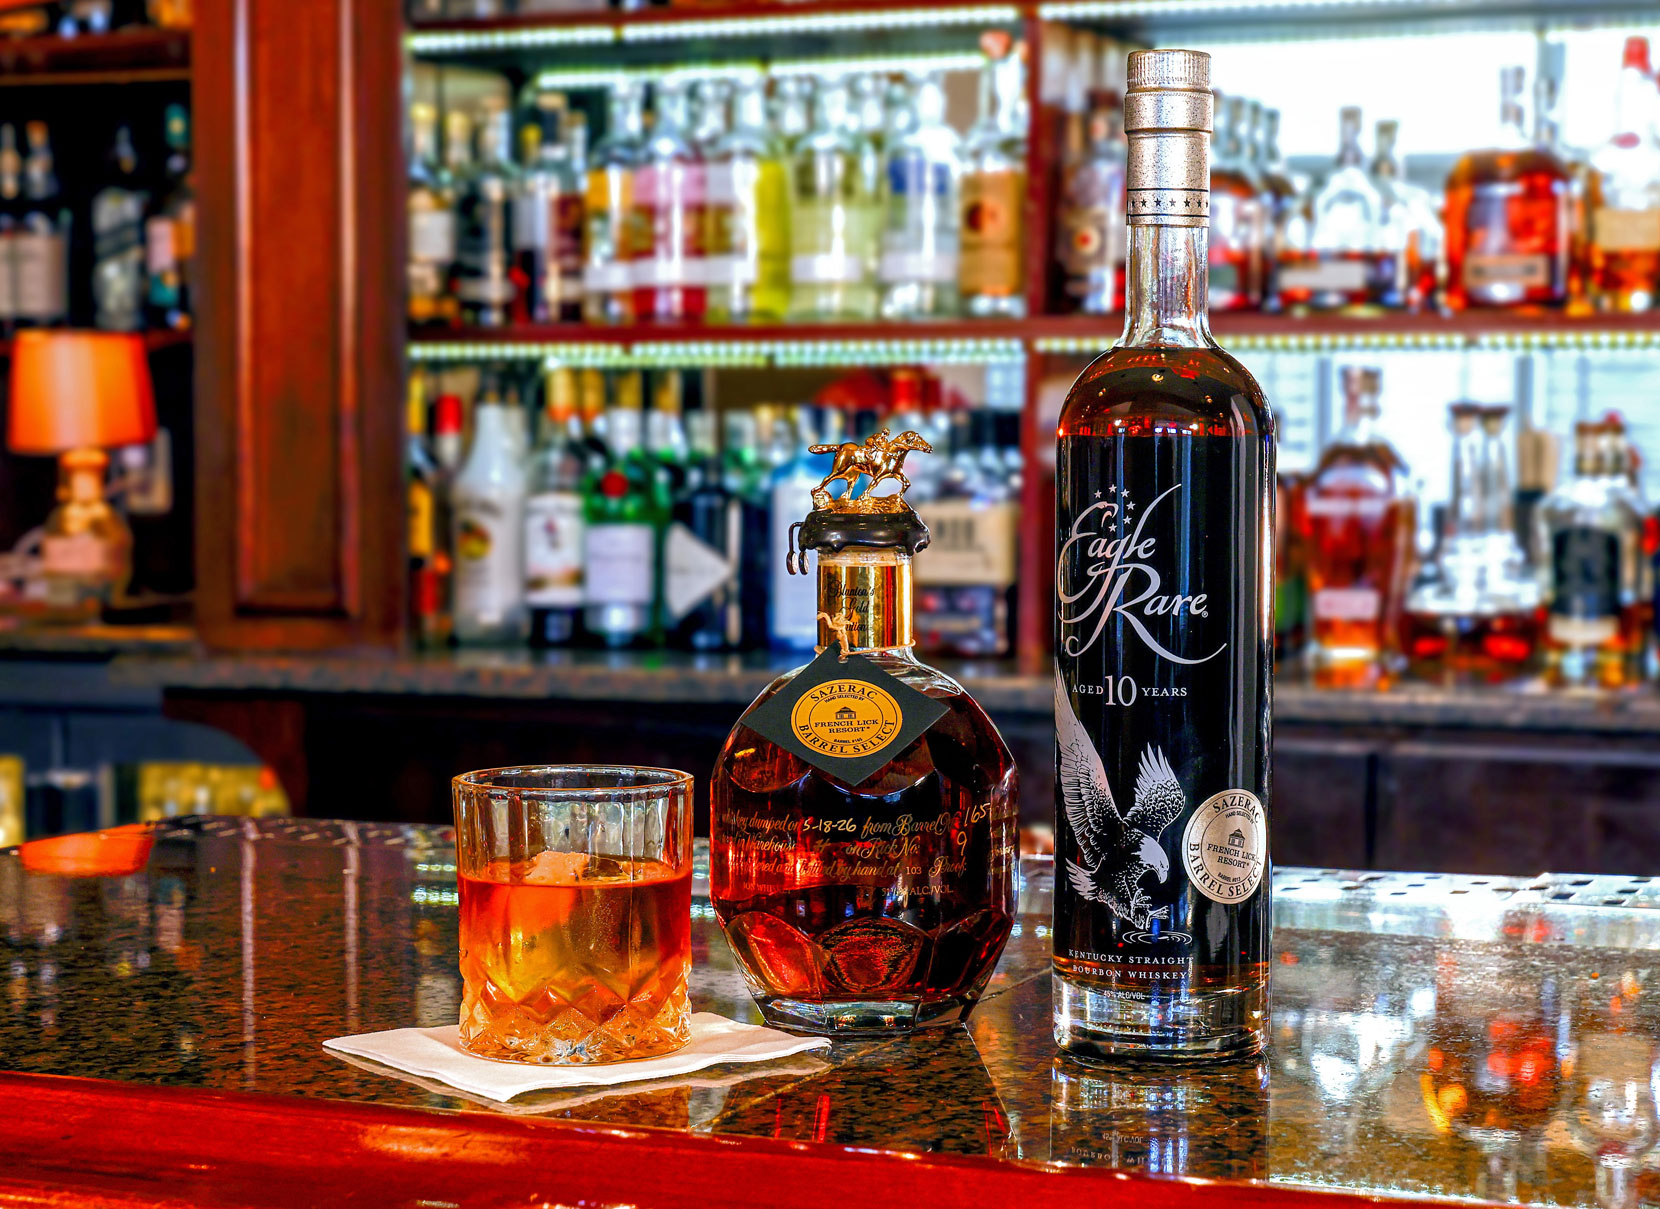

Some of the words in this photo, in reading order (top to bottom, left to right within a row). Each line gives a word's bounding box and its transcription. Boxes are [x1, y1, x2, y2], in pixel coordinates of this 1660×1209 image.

[1058, 484, 1181, 623] Eagle
[829, 580, 875, 598] Blanton's
[839, 597, 870, 620] Gold
[1066, 563, 1227, 664] Rare
[810, 684, 878, 702] SAZERAC
[1072, 684, 1104, 695] AGED
[1105, 675, 1137, 706] 10
[1142, 687, 1187, 697] YEARS
[814, 719, 853, 728] FRENCH
[857, 719, 879, 727] LICK
[799, 724, 848, 754] BARREL
[852, 720, 895, 753] SELECT
[749, 811, 786, 834] dumped
[803, 817, 857, 833] 5-18-26
[860, 816, 892, 839] from
[891, 813, 944, 836] Barrel
[963, 802, 991, 827] 165
[1212, 795, 1261, 823] SAZERAC
[956, 830, 967, 857] 9
[1207, 843, 1240, 857] FRENCH
[852, 861, 888, 877] hand
[905, 866, 922, 875] 103
[1189, 842, 1224, 896] BARREL
[1227, 860, 1262, 897] SELECT
[1068, 948, 1123, 963] KENTUCKY
[1128, 956, 1195, 965] STRAIGHT
[1072, 964, 1122, 978] BOURBON
[1128, 971, 1188, 980] WHISKEY
